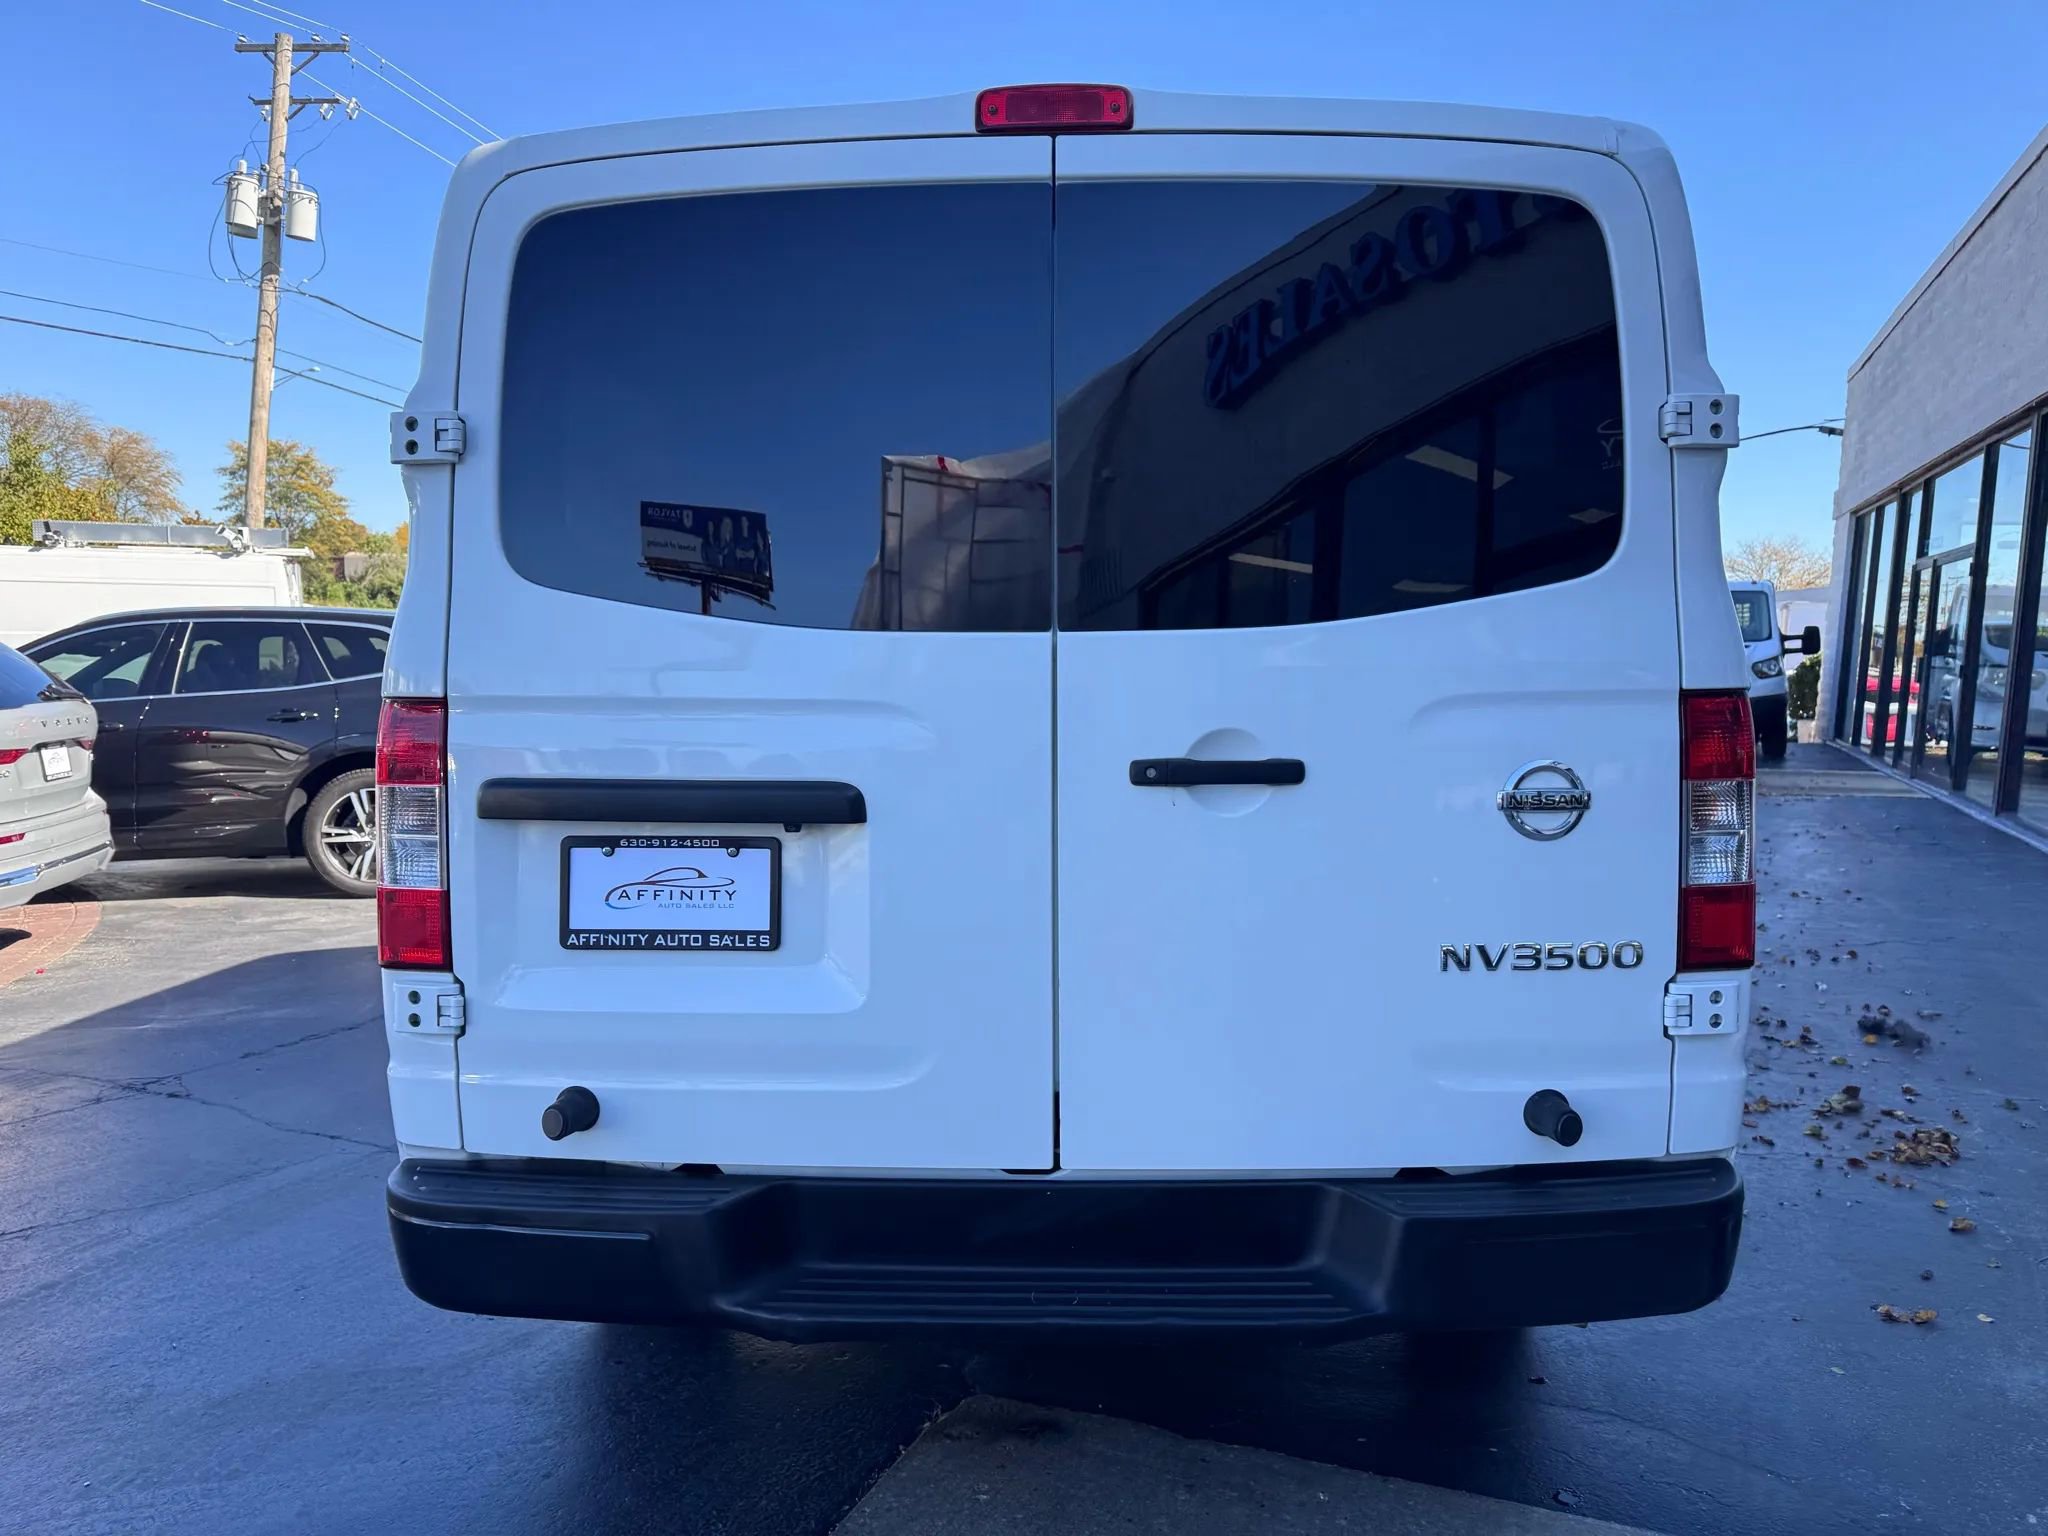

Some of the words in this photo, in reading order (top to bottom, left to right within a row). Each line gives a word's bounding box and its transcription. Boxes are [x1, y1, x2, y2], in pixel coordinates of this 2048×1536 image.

[1508, 793, 1584, 807] NISSAN
[620, 838, 720, 848] 630-912-4500
[617, 889, 737, 901] AFFINITY
[567, 933, 649, 946] AFFINITY
[654, 933, 702, 947] AUTO
[708, 933, 771, 948] SALES
[1440, 940, 1644, 972] NV3500
